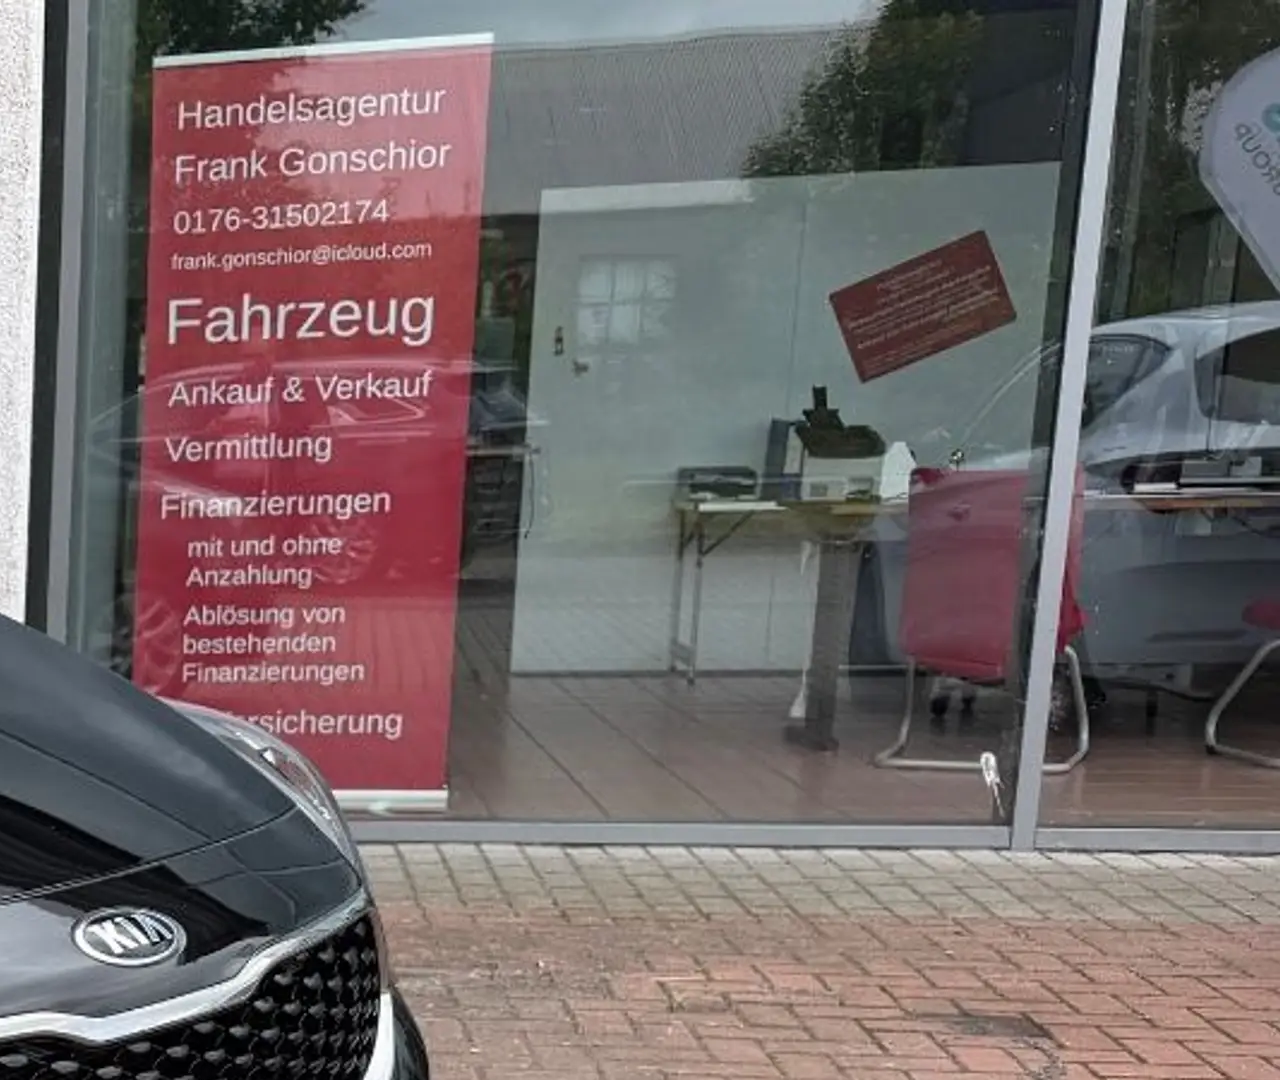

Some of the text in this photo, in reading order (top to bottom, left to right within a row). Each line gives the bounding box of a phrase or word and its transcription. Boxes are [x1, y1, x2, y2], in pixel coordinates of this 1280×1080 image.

[178, 88, 446, 131] Handelsagentur
[175, 139, 451, 184] Frank Gonschior
[173, 199, 390, 235] 0176-31502174
[171, 242, 432, 272] frank.gonschior@icloud.com
[168, 293, 434, 347] Fahrzeug
[168, 369, 433, 408] Ankauf & Verkauf
[165, 432, 332, 463] Vermittlung
[161, 490, 391, 520] Finanzierungen
[187, 534, 343, 558] mit und ohne
[185, 564, 312, 589] Anzahlung
[183, 604, 346, 628] Ablösung von
[183, 633, 336, 655] bestehenden
[182, 662, 365, 686] Finanzierungen
[248, 709, 402, 740] sicherung
[86, 914, 174, 955] KIA
